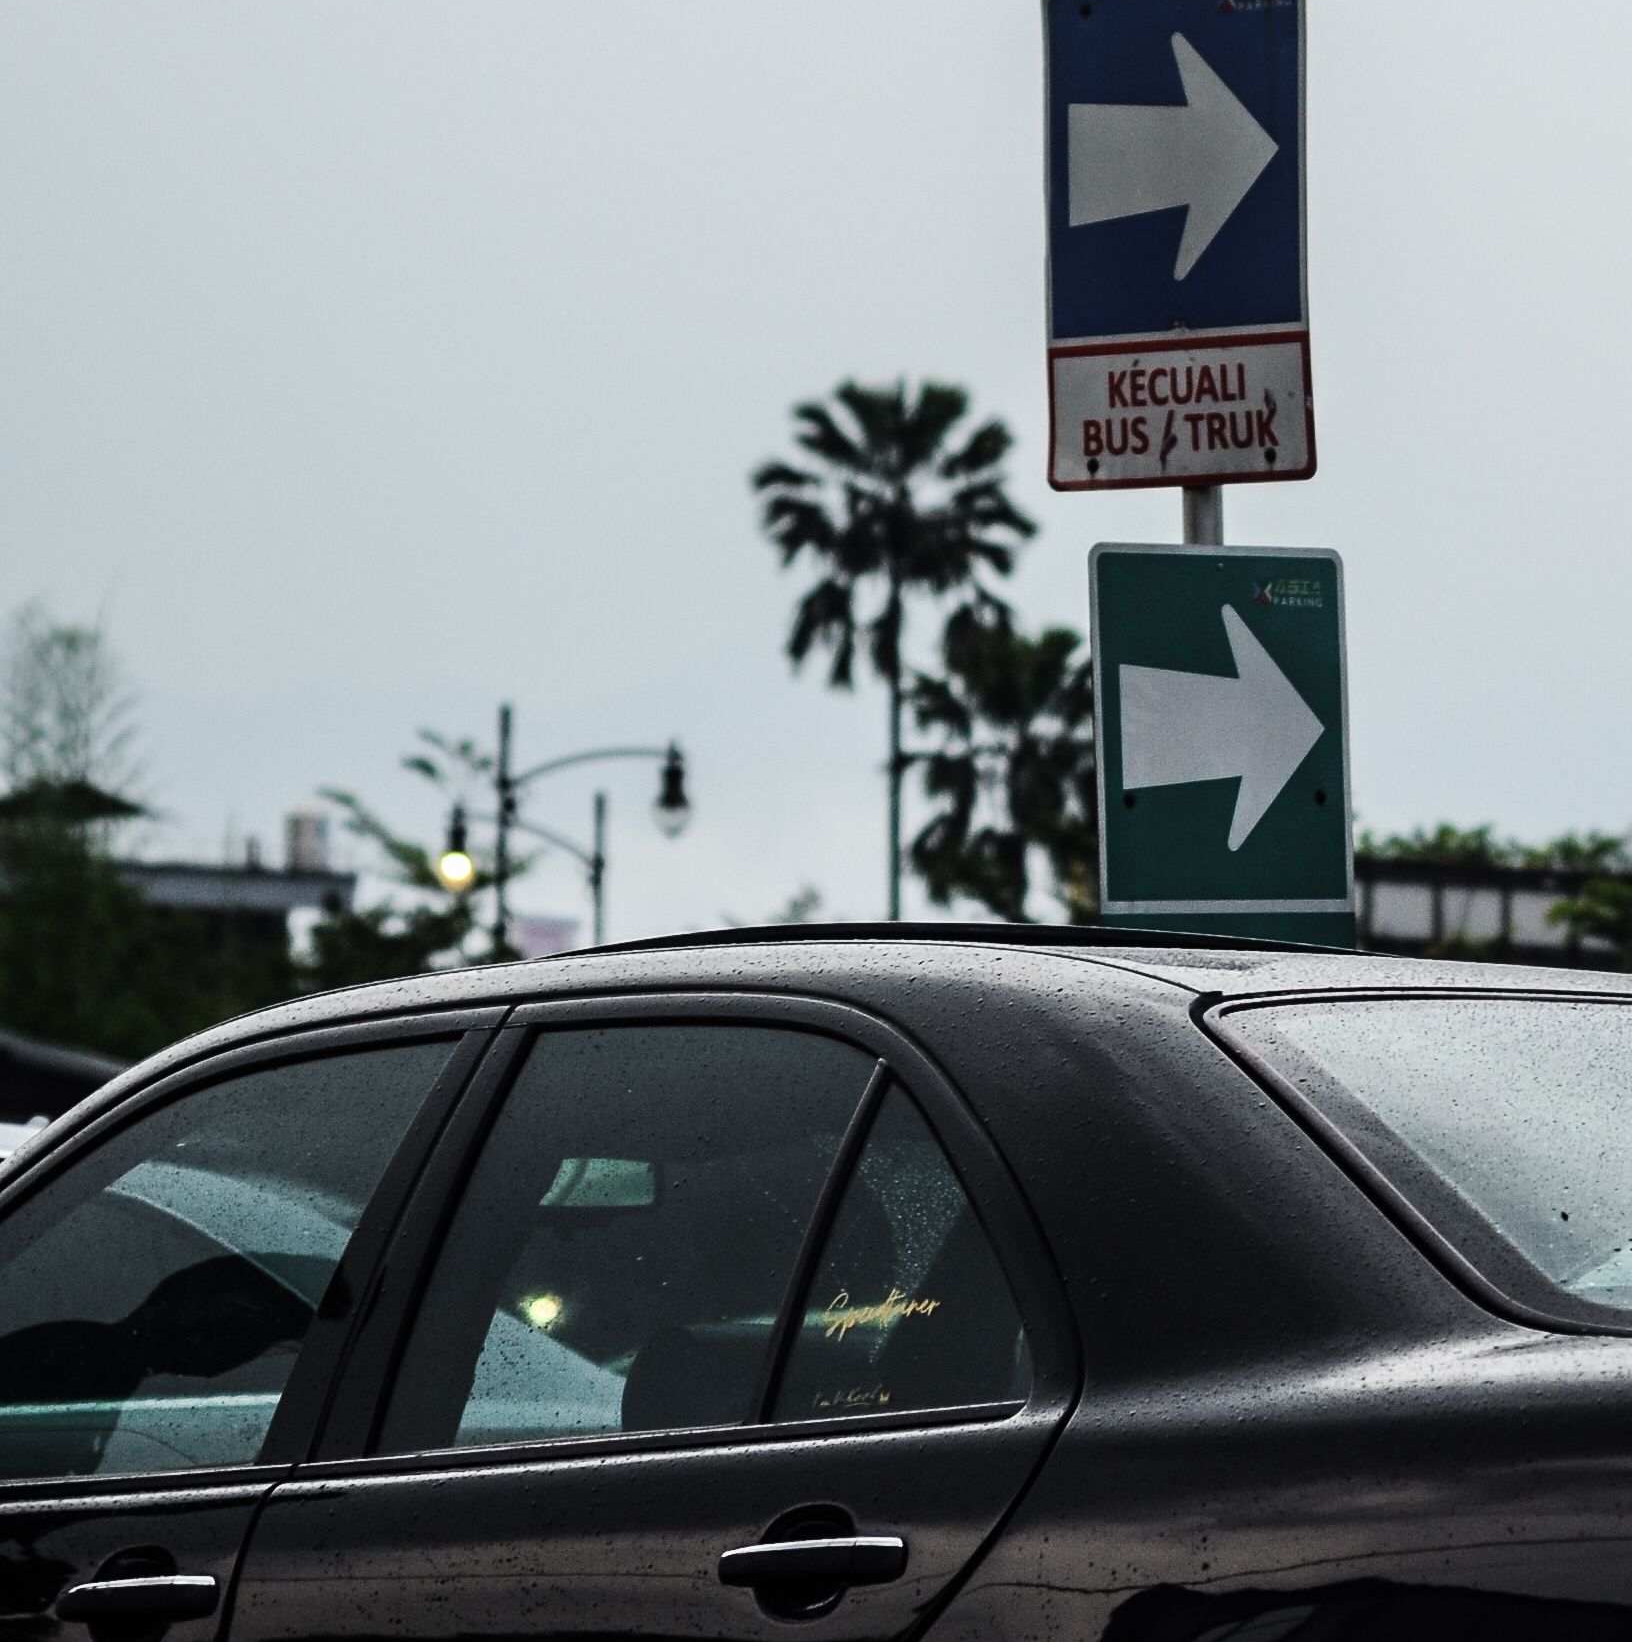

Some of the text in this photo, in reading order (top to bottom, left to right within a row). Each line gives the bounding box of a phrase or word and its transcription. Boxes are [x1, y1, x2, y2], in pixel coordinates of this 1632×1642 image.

[1108, 363, 1245, 407] KECUALI
[1083, 417, 1149, 456] BUS
[1184, 407, 1279, 450] TRUK
[1272, 596, 1323, 608] PARKING
